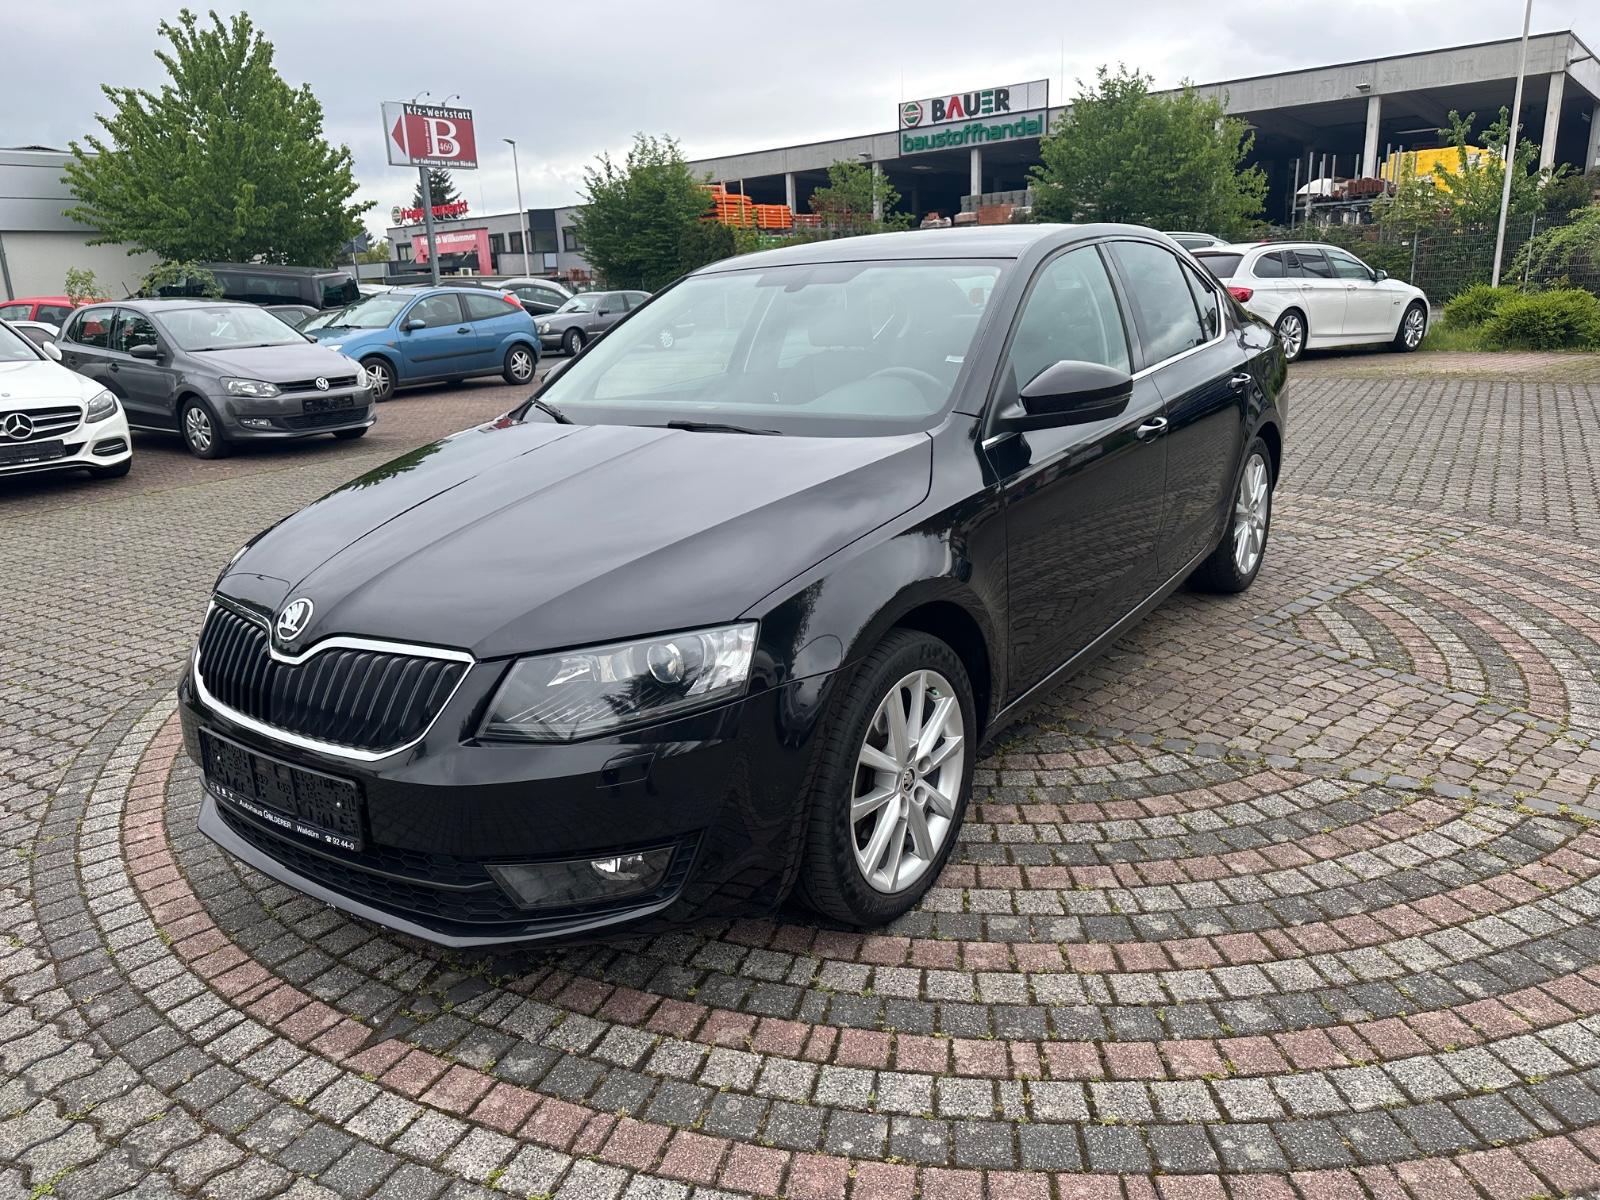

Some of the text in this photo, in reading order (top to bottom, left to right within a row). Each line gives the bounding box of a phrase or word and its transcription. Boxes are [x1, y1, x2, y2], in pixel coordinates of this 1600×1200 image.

[405, 105, 471, 120] Kfz-Werkstatt
[931, 88, 1010, 122] BAUER
[423, 117, 461, 157] B
[902, 113, 1043, 152] baustoffhandel
[332, 837, 340, 846] 92
